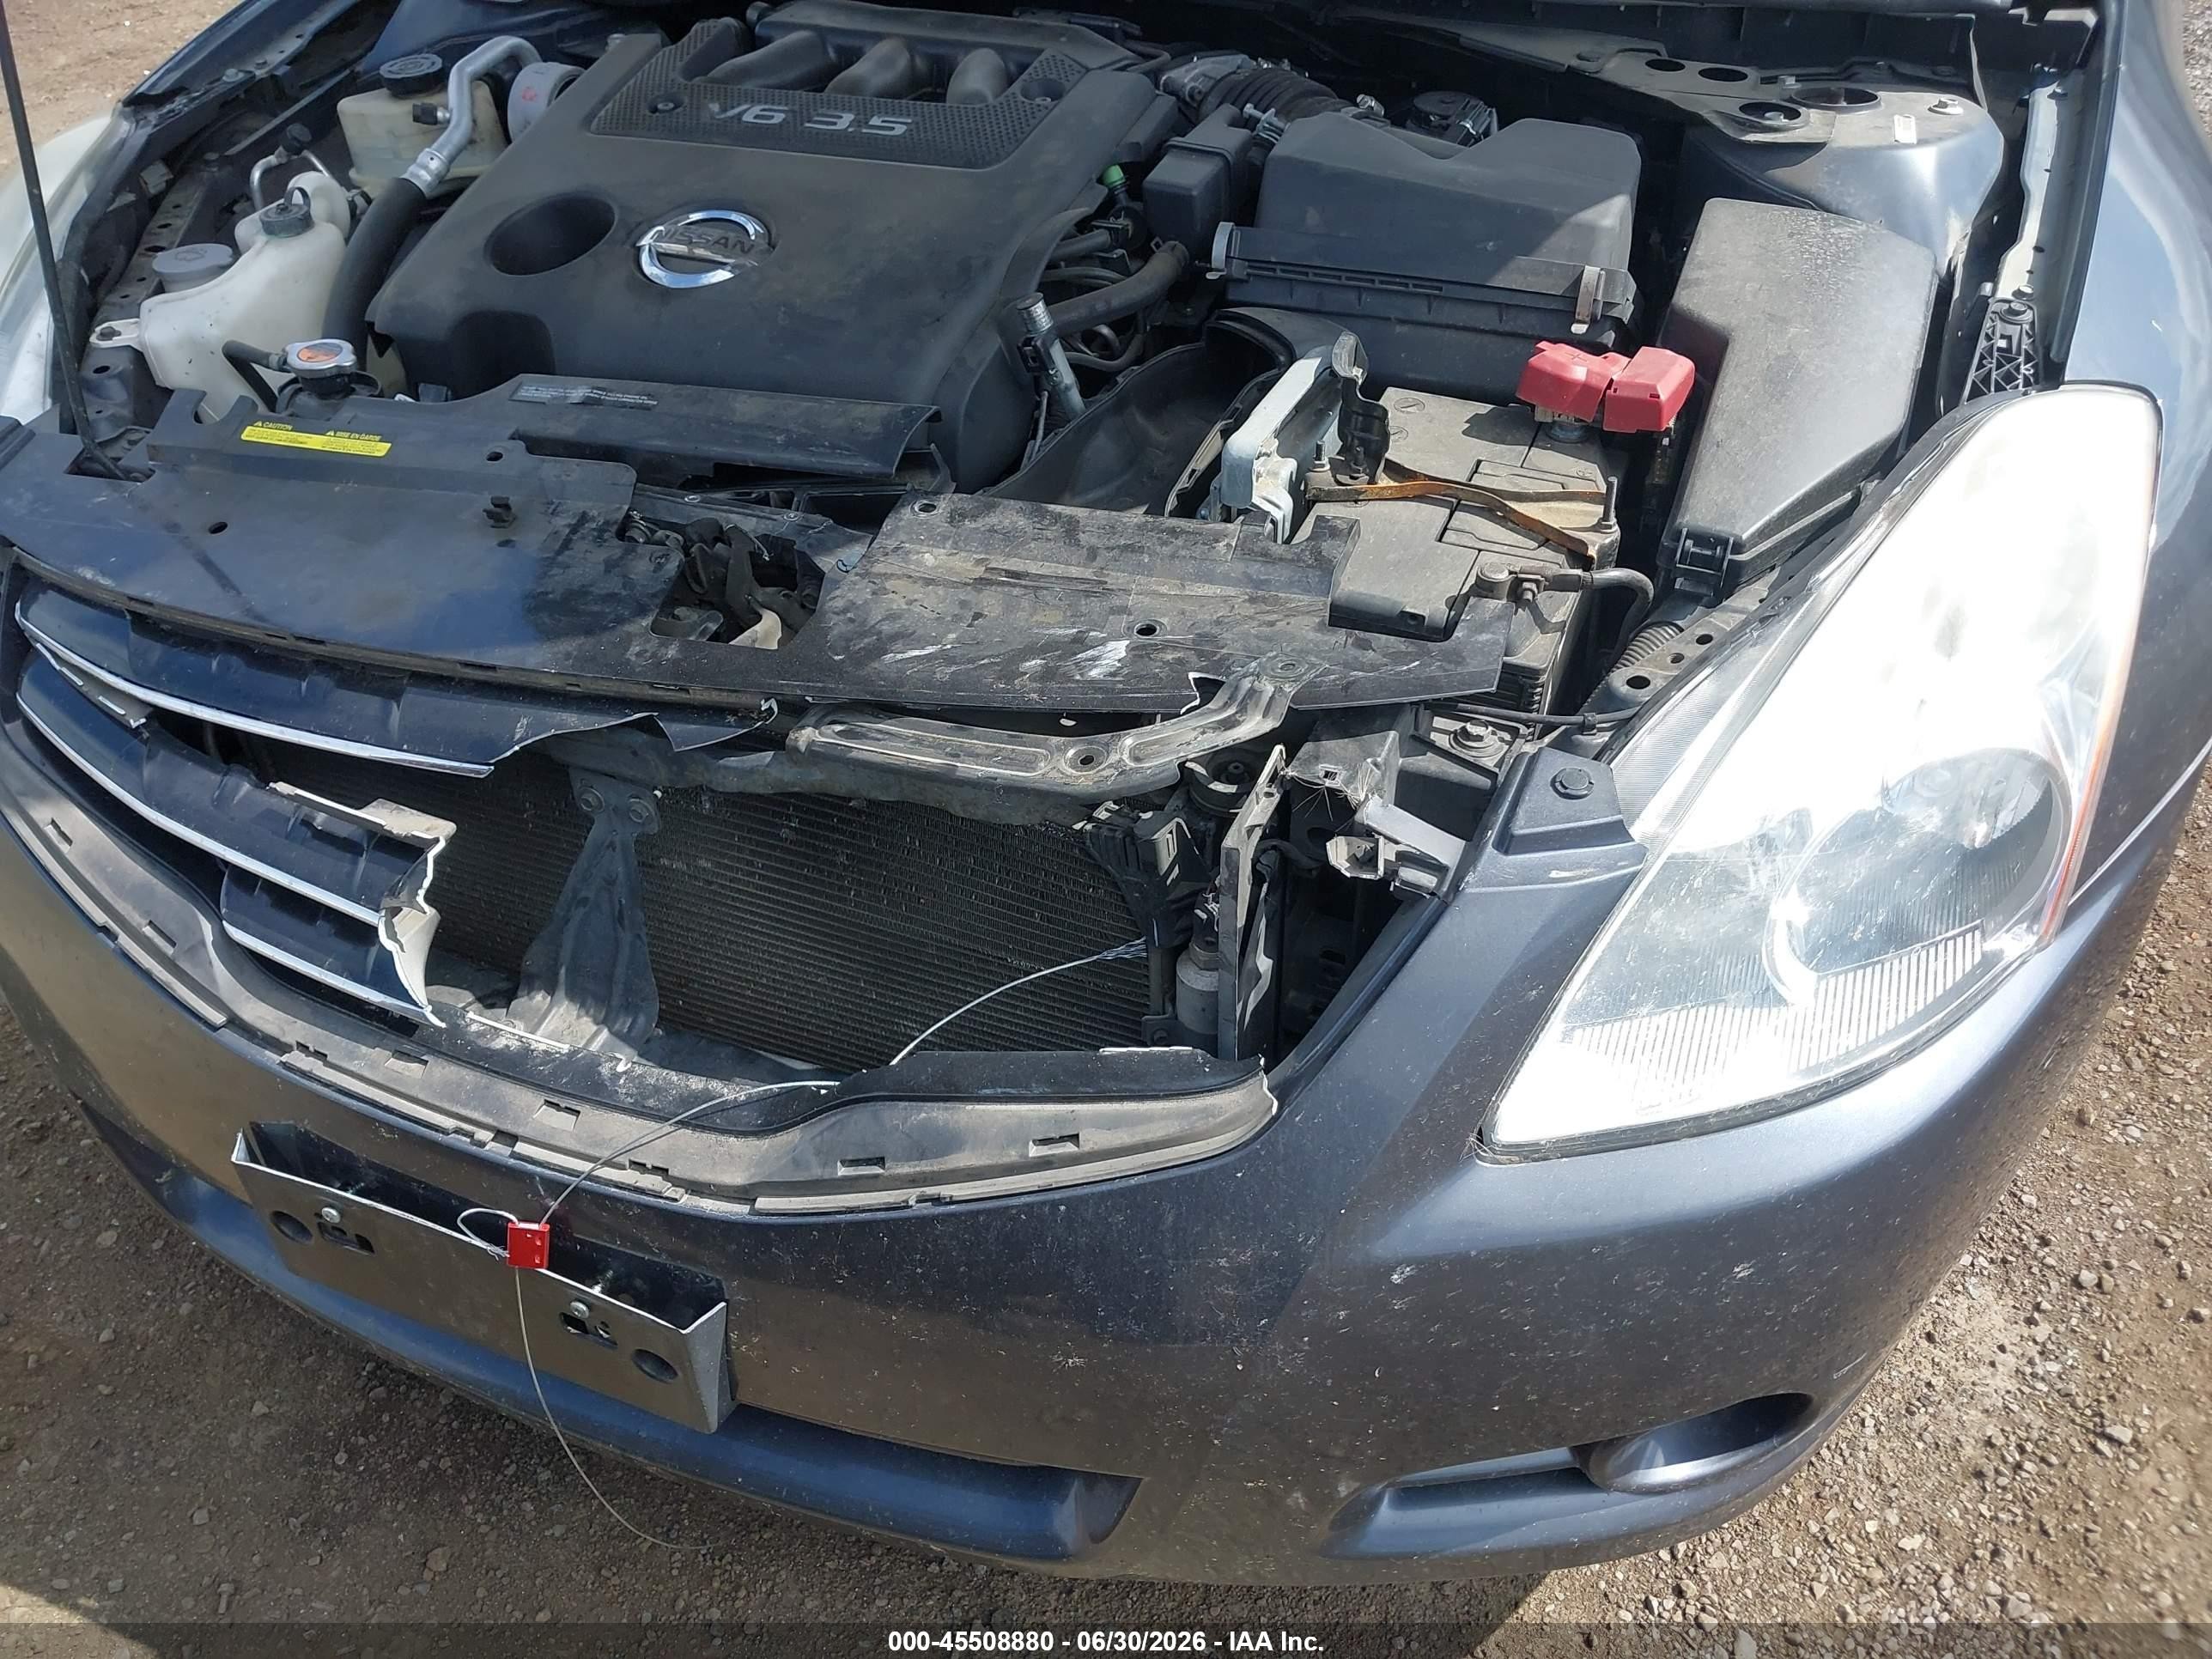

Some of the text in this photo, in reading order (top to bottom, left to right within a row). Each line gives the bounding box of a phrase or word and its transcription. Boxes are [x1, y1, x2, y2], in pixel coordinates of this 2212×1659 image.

[708, 102, 913, 137] V6 3.5
[652, 224, 756, 255] NISSAN
[263, 421, 294, 431] CAUTION
